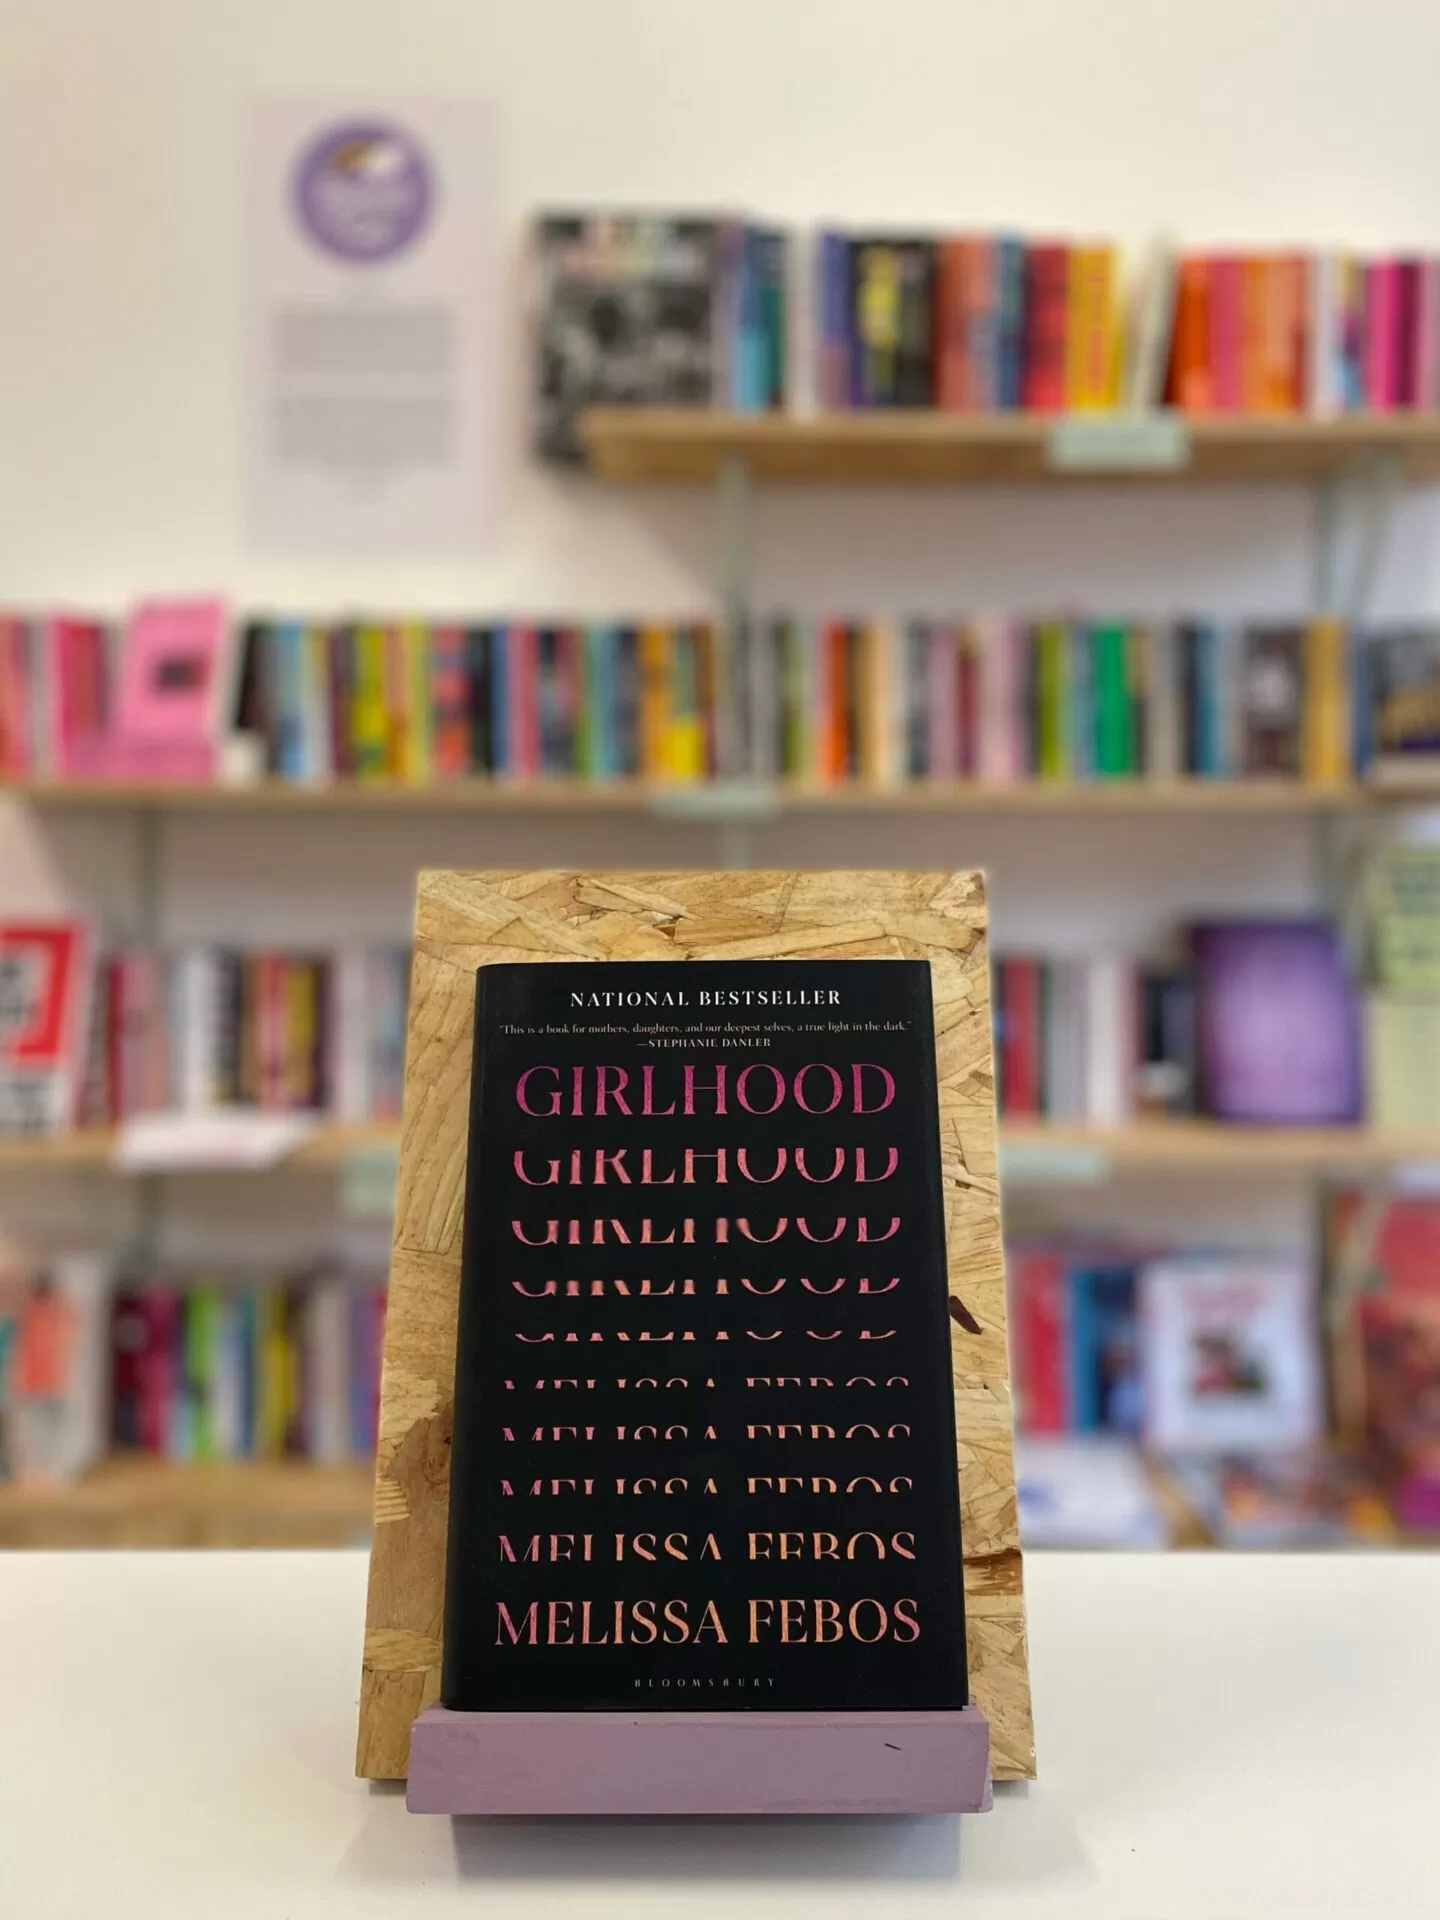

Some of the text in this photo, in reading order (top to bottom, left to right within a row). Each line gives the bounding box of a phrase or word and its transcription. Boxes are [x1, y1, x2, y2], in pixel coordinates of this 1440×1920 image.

[571, 990, 841, 1007] NATIONAL BESTSELLER
[527, 1024, 536, 1034] is
[546, 1023, 570, 1034] book
[572, 1023, 586, 1034] for
[588, 1023, 630, 1035] mothers,
[632, 1022, 682, 1035] daughters,
[685, 1022, 703, 1033] and
[705, 1025, 721, 1033] our
[723, 1022, 761, 1034] deepest
[763, 1021, 794, 1033] selves,
[805, 1023, 826, 1032] true
[828, 1021, 850, 1033] light
[852, 1021, 863, 1031] in
[864, 1020, 881, 1031] the
[722, 1038, 771, 1047] DANLER
[515, 1063, 896, 1117] GIRLHOOD
[495, 1598, 921, 1645] MELISSA FEBOS
[633, 1678, 776, 1688] BLOOMSBURY
